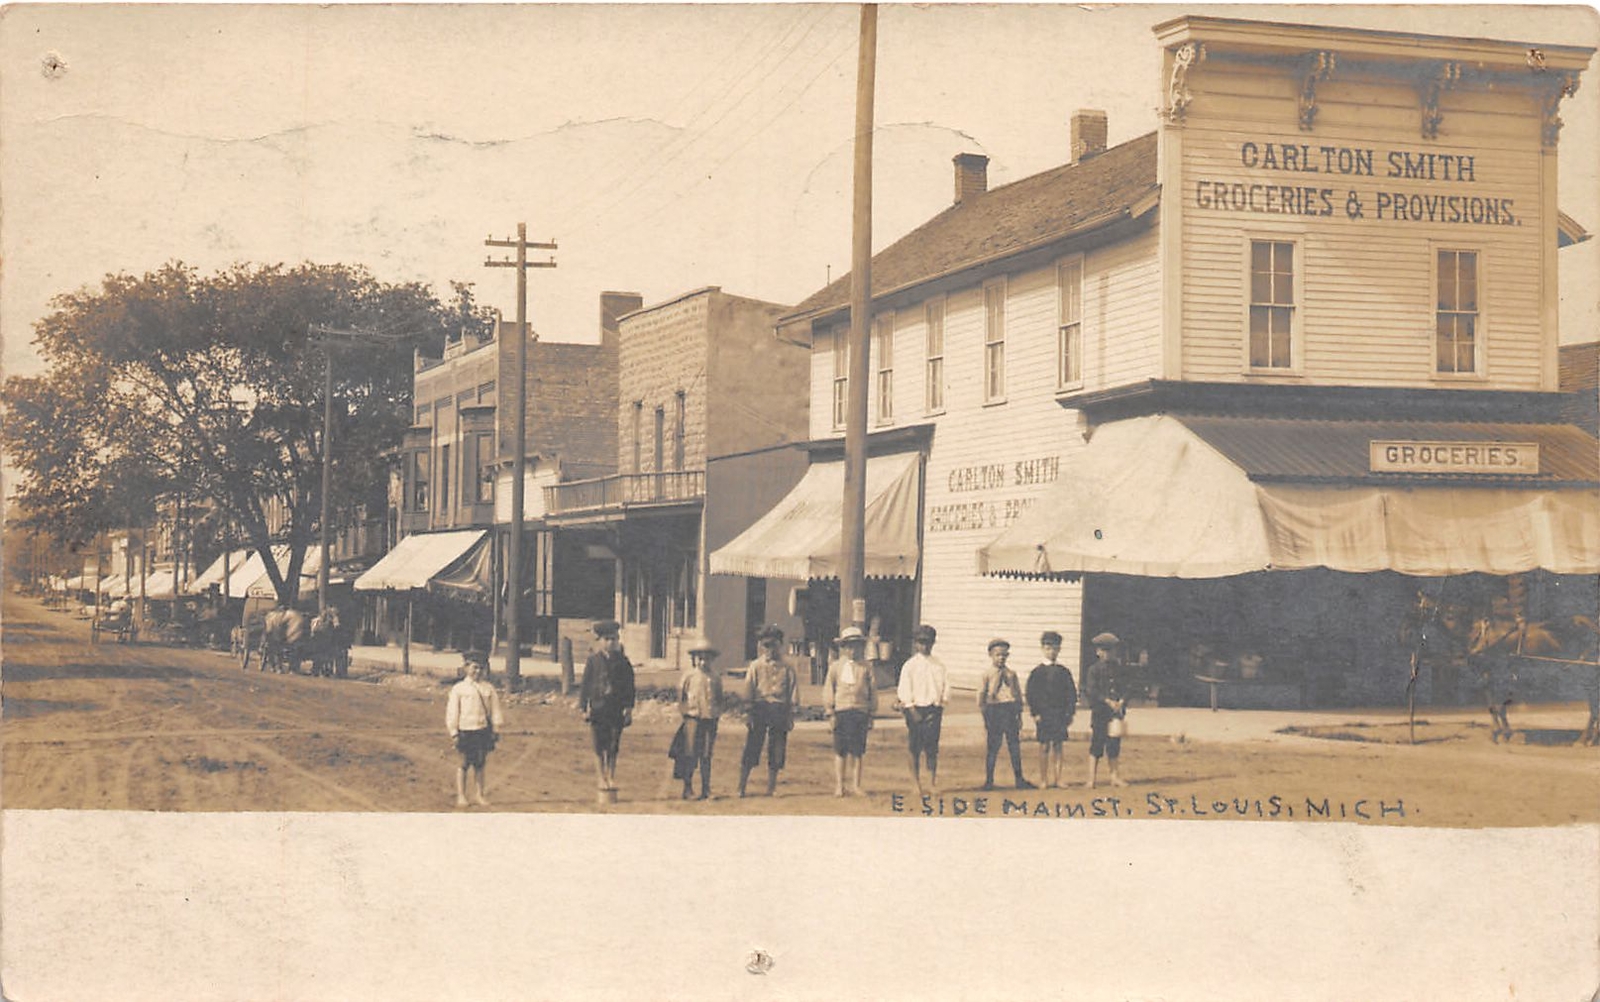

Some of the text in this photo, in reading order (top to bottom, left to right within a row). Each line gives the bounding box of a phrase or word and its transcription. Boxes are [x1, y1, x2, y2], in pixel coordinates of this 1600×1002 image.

[1241, 142, 1475, 182] CARLTON SMITH
[1197, 181, 1522, 226] GROCERIES & PROVISIONS.
[949, 456, 1060, 492] CARLTON SMITH
